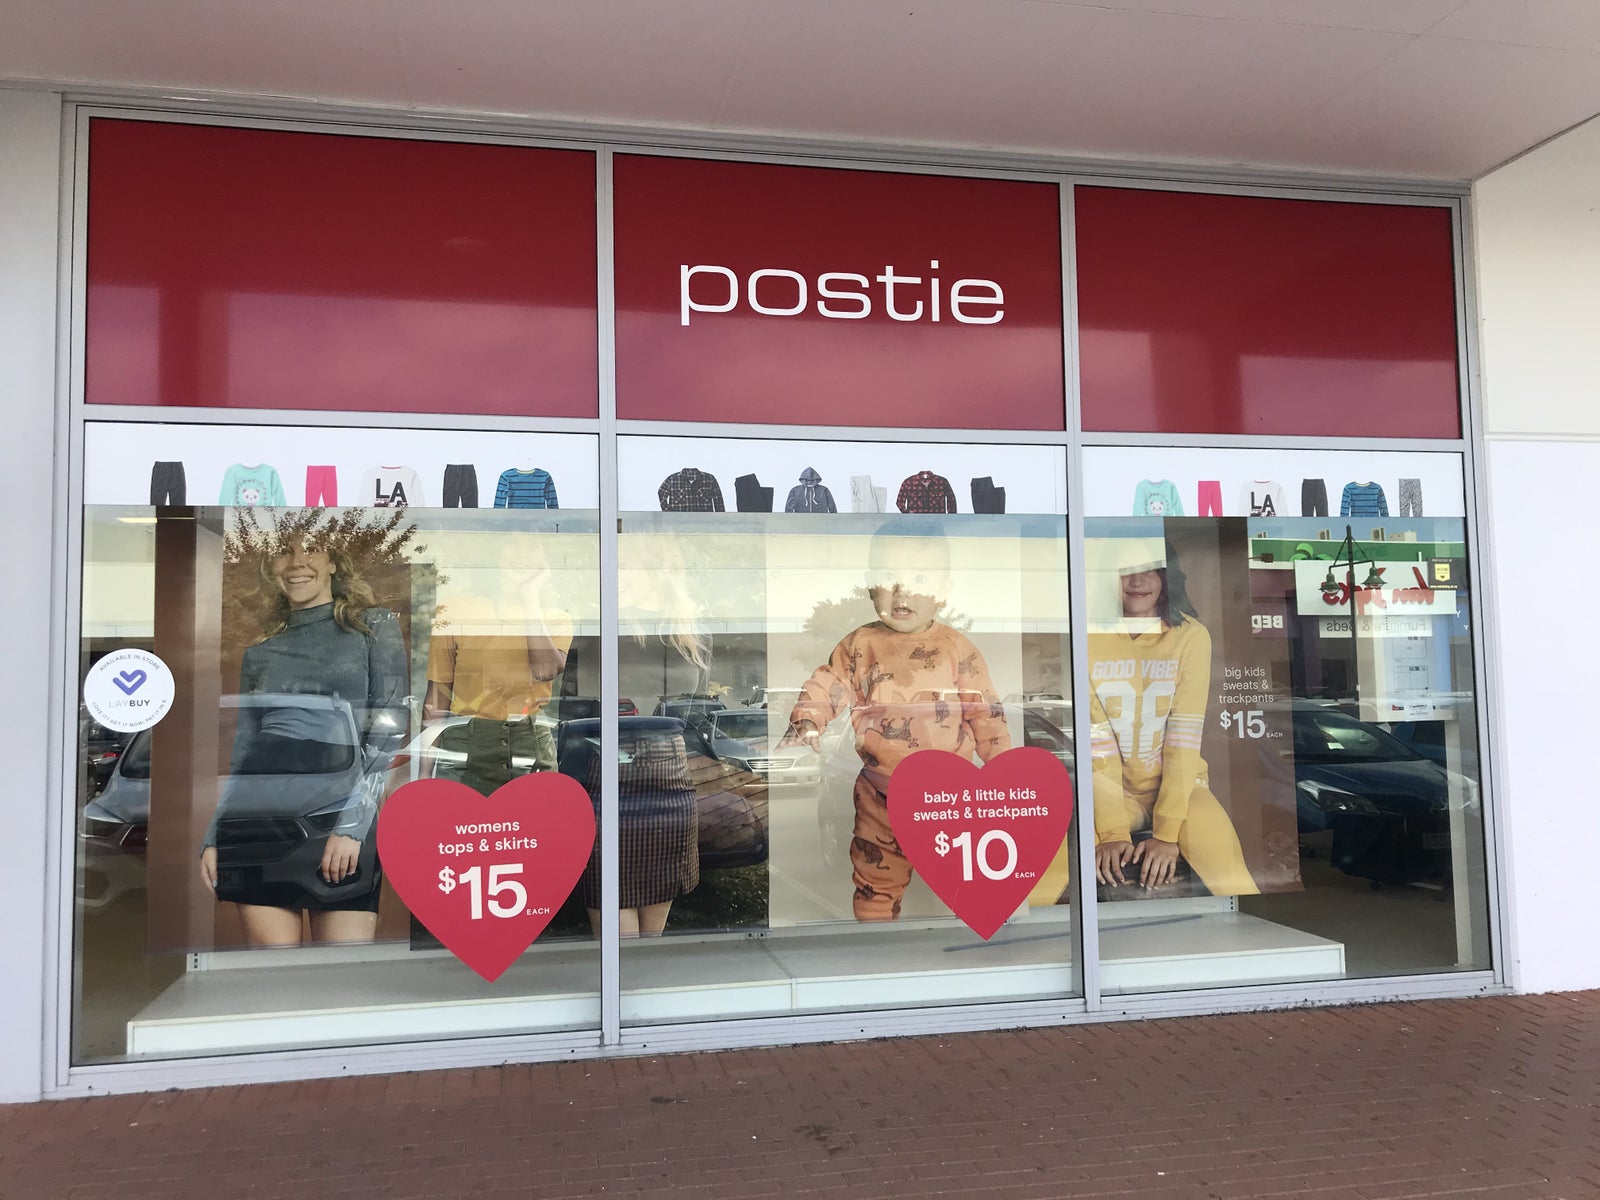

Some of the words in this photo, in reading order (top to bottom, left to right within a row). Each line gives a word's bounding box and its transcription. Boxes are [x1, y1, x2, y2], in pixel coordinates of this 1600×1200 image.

[680, 260, 1005, 326] postie
[375, 478, 408, 503] LA
[1250, 491, 1276, 513] LA
[100, 654, 131, 671] AVAILABLE
[142, 656, 160, 670] STORE
[1092, 659, 1137, 679] GOOD
[1224, 666, 1242, 680] big
[1244, 666, 1266, 677] kids
[1222, 680, 1259, 691] sweats
[1261, 679, 1269, 690] &
[108, 699, 150, 708] LAYBUY
[1218, 693, 1274, 706] trackpants
[1220, 709, 1266, 739] $15
[924, 791, 958, 805] baby
[962, 789, 972, 802] &
[975, 788, 1006, 801] little
[1009, 787, 1037, 800] kids
[913, 808, 960, 821] sweats
[963, 806, 973, 819] &
[977, 805, 1049, 820] trackpants
[455, 821, 520, 834] womens
[438, 842, 474, 857] tops
[479, 838, 490, 852] &
[495, 836, 538, 851] skirts
[934, 829, 1018, 881] $10
[1014, 871, 1036, 879] EACH
[438, 863, 528, 920] $15
[526, 907, 550, 916] EACH
